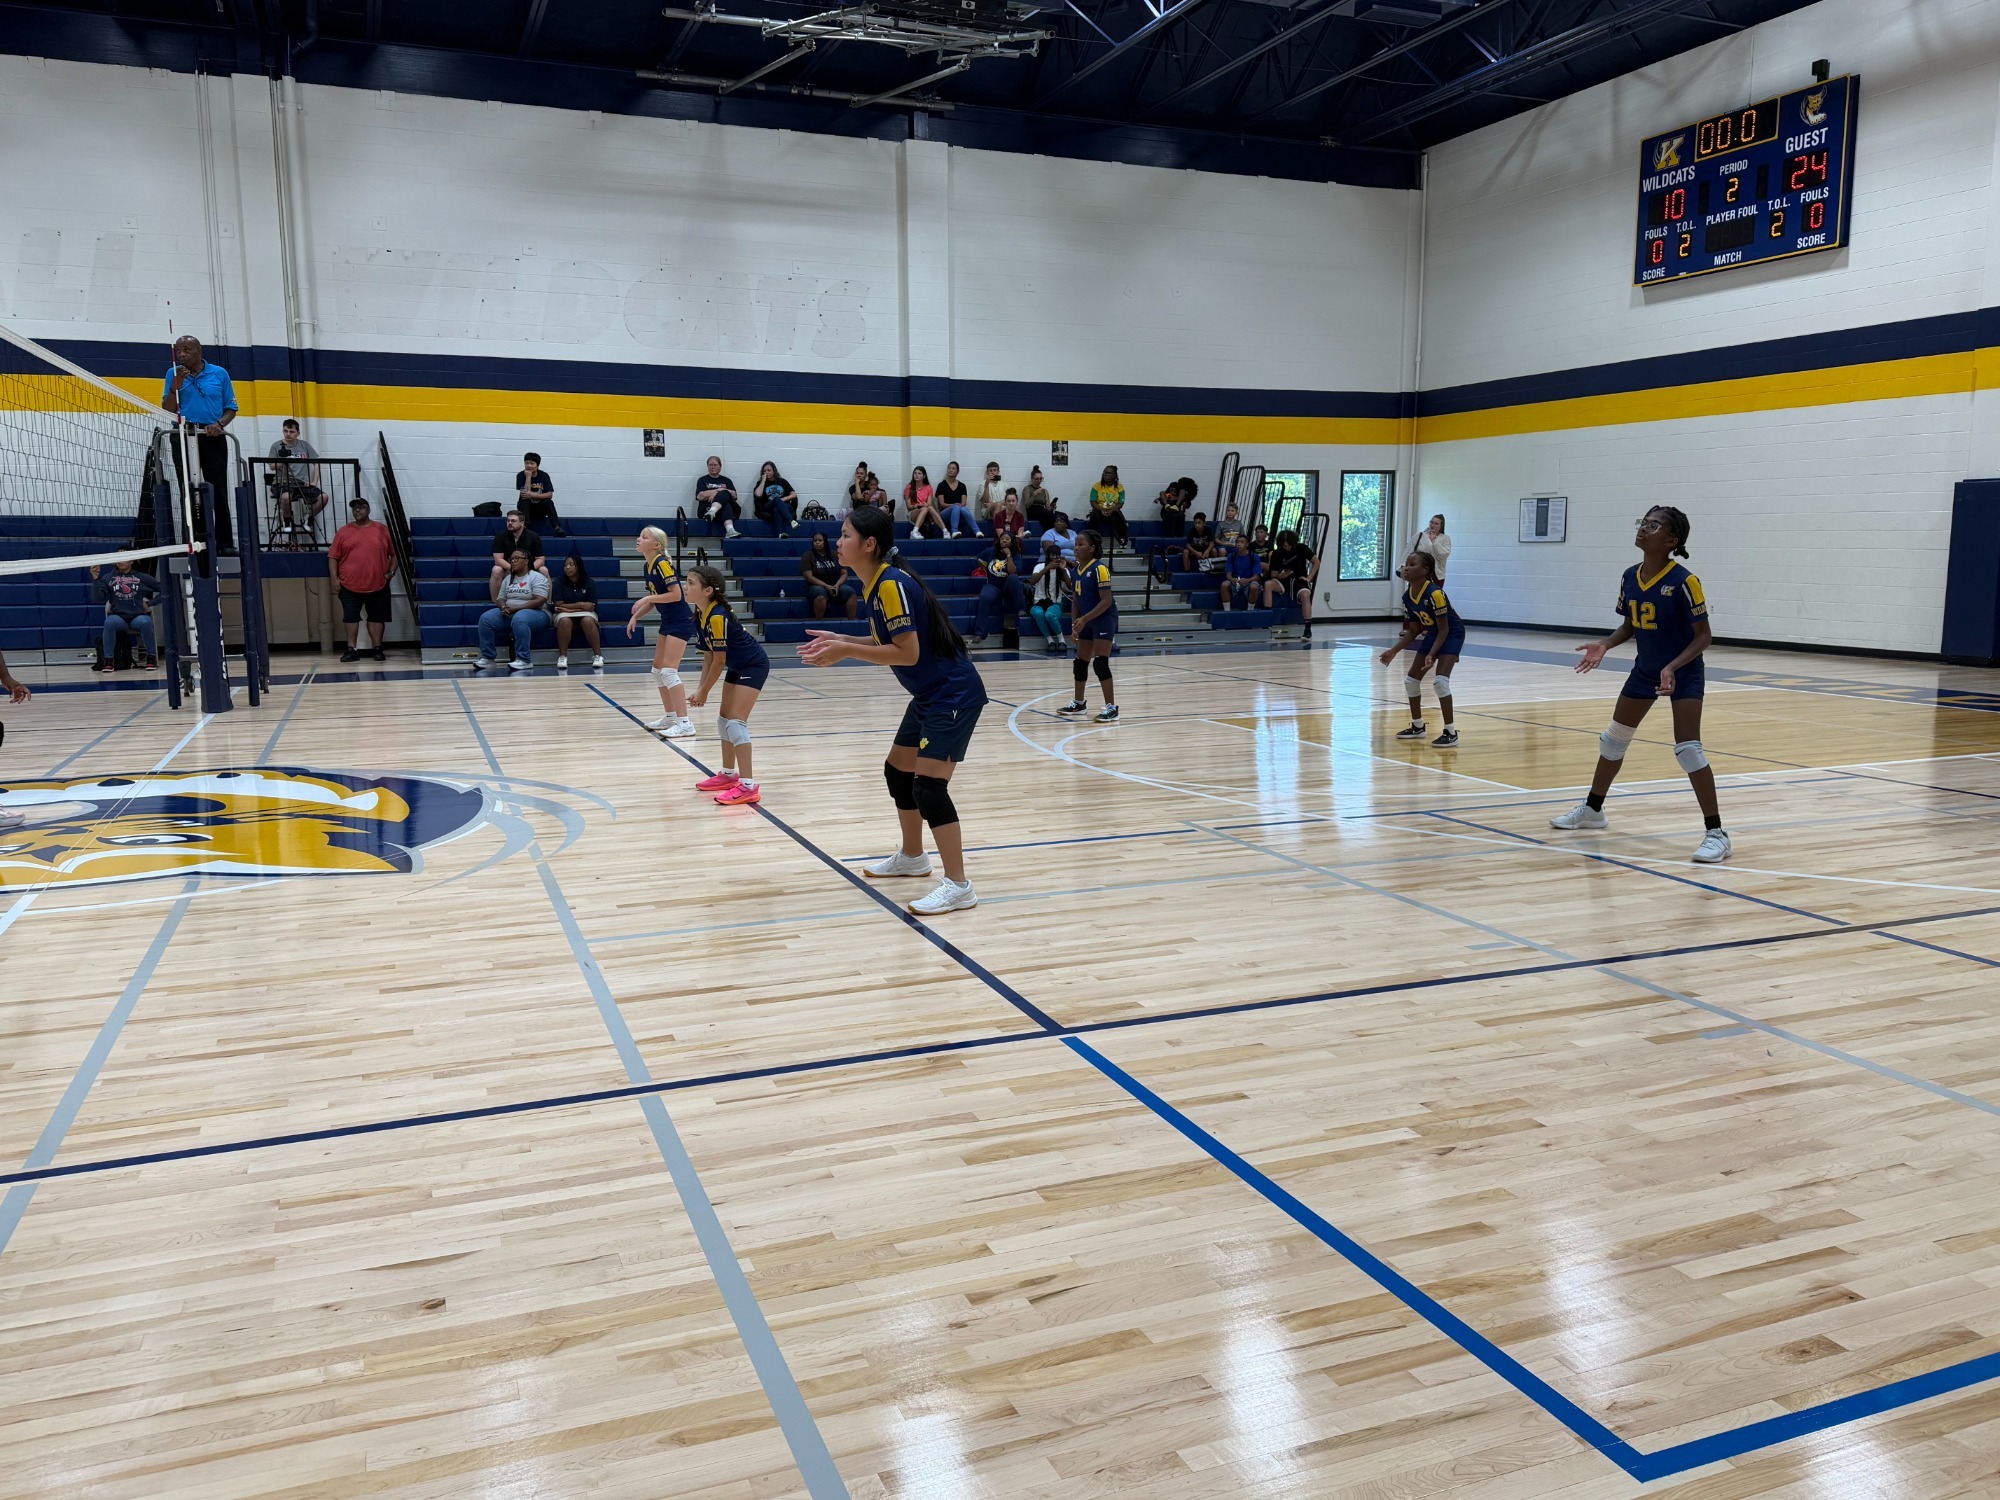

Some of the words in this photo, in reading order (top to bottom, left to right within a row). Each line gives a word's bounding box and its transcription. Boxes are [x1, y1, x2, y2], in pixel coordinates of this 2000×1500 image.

[1700, 109, 1756, 154] 00.0
[1785, 127, 1828, 153] GUEST
[1643, 165, 1695, 193] WILDCATS
[1719, 159, 1748, 176] PERIOD
[1791, 151, 1827, 189] 24
[1727, 178, 1738, 203] 2
[1800, 187, 1829, 203] FOULS
[1664, 188, 1685, 220] 10
[1706, 209, 1736, 226] PLAYER
[1737, 204, 1758, 219] FOUL
[1767, 197, 1791, 211] T.O.L.
[1810, 203, 1824, 228] 0
[1645, 226, 1668, 240] FOULS
[1676, 220, 1697, 233] T.O.L.
[1771, 211, 1784, 237] 2
[1652, 240, 1664, 263] 0
[1679, 233, 1690, 257] 2
[1797, 233, 1825, 248] SCORE
[1713, 251, 1742, 266] MATCH
[1642, 267, 1666, 280] SCORE
[1628, 600, 1658, 630] 12
